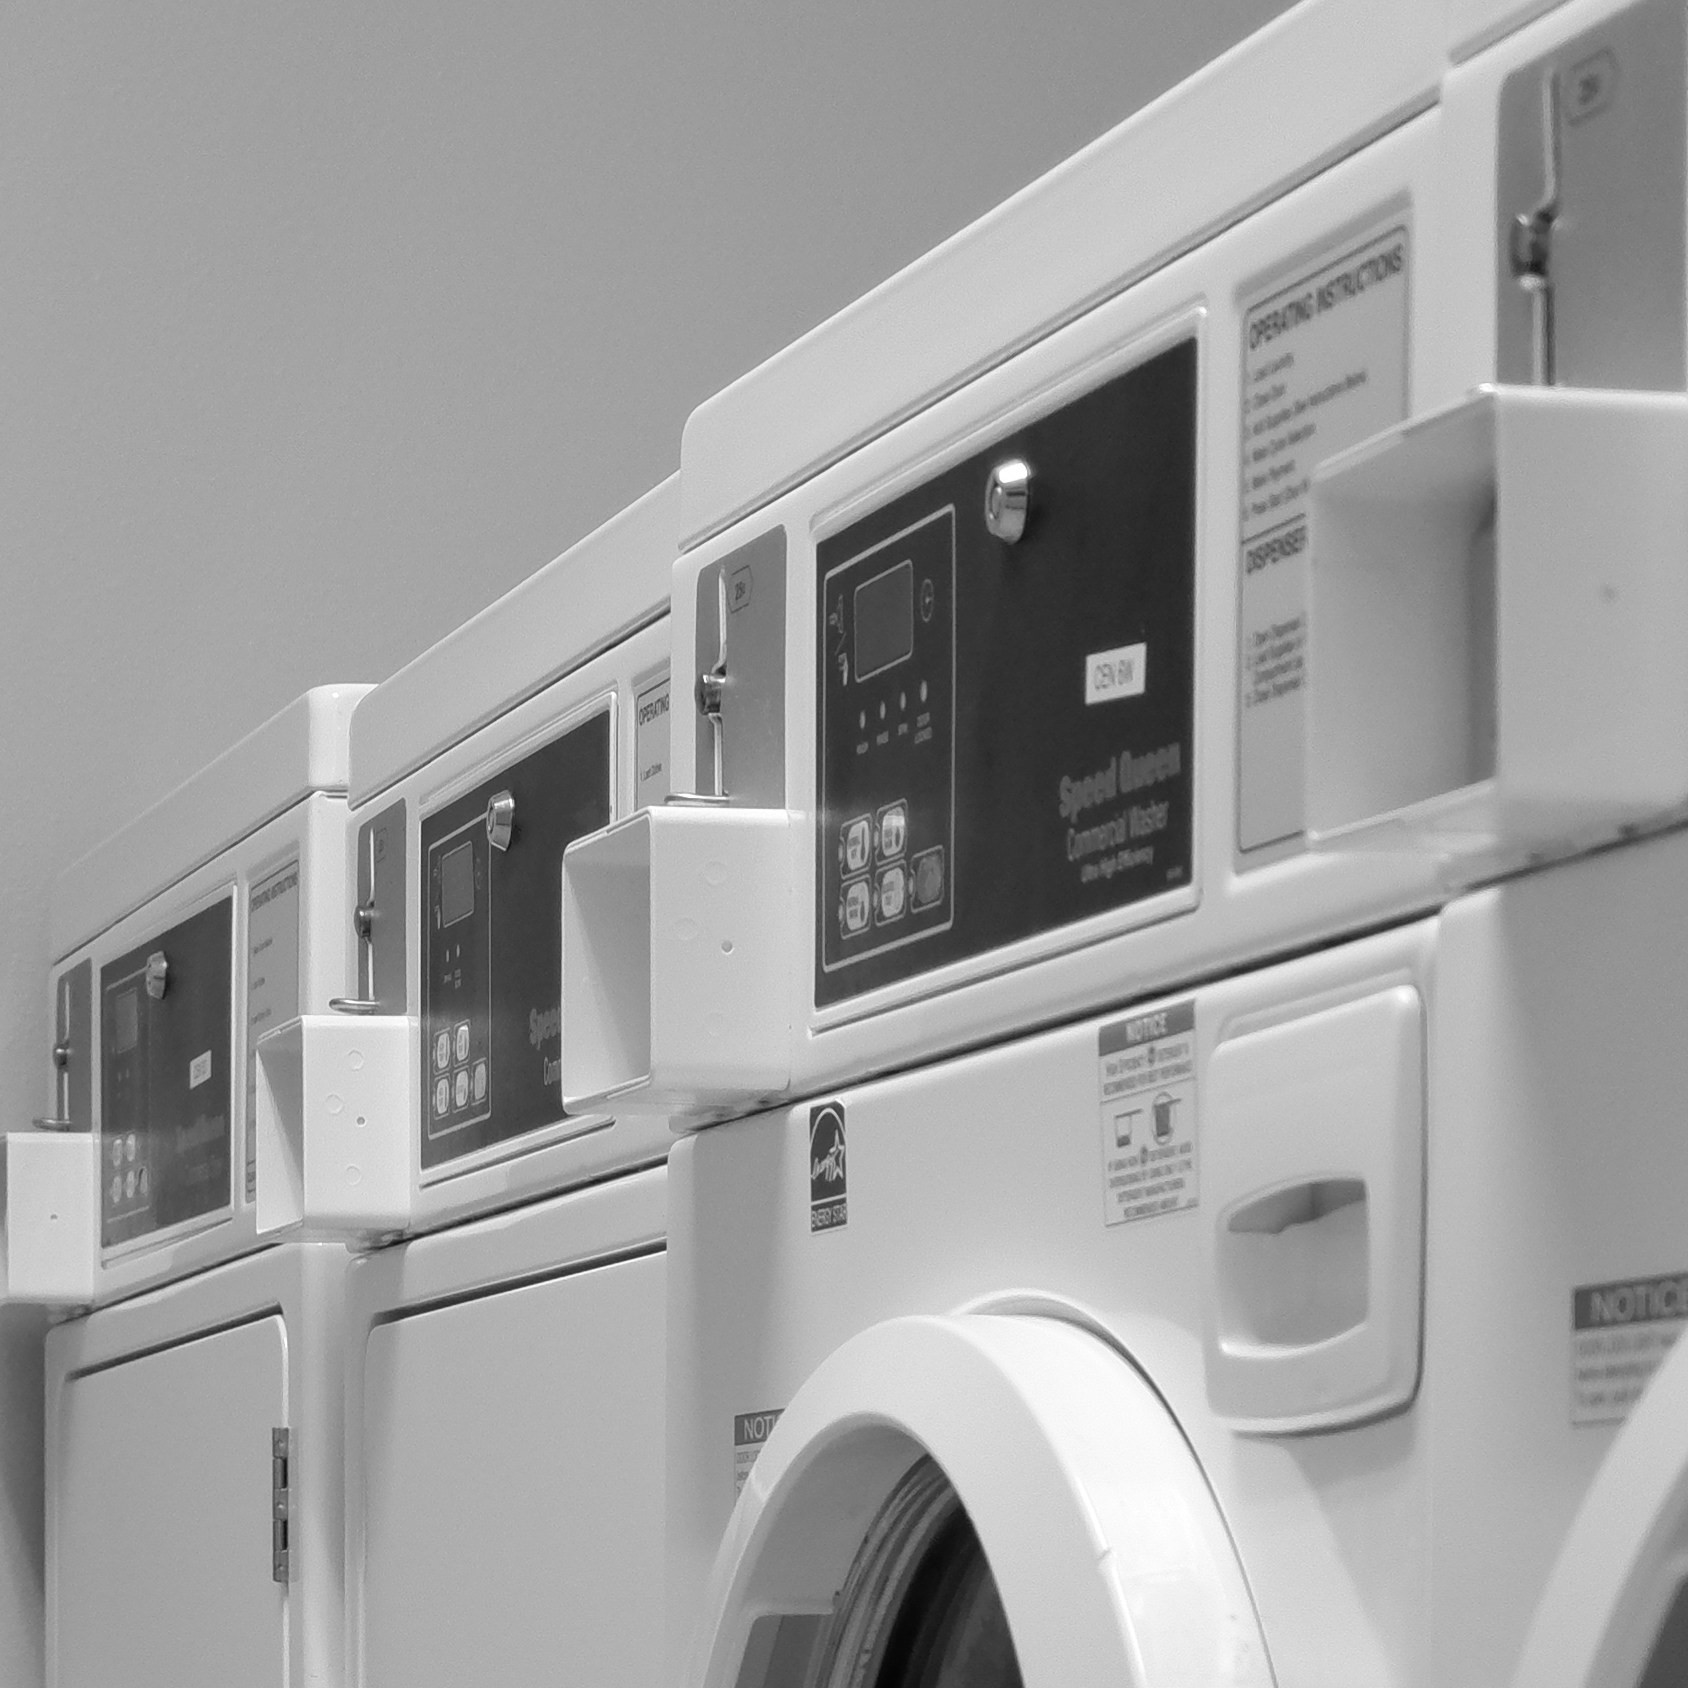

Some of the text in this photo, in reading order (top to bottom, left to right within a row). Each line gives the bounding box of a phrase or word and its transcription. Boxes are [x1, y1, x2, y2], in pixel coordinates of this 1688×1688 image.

[1249, 243, 1402, 350] OPERATING INSTRUCTIONS
[639, 693, 669, 726] OPERATING
[1059, 741, 1181, 824] Speed Queen
[1067, 807, 1127, 862] Commercial
[1126, 1011, 1168, 1043] NOTICE
